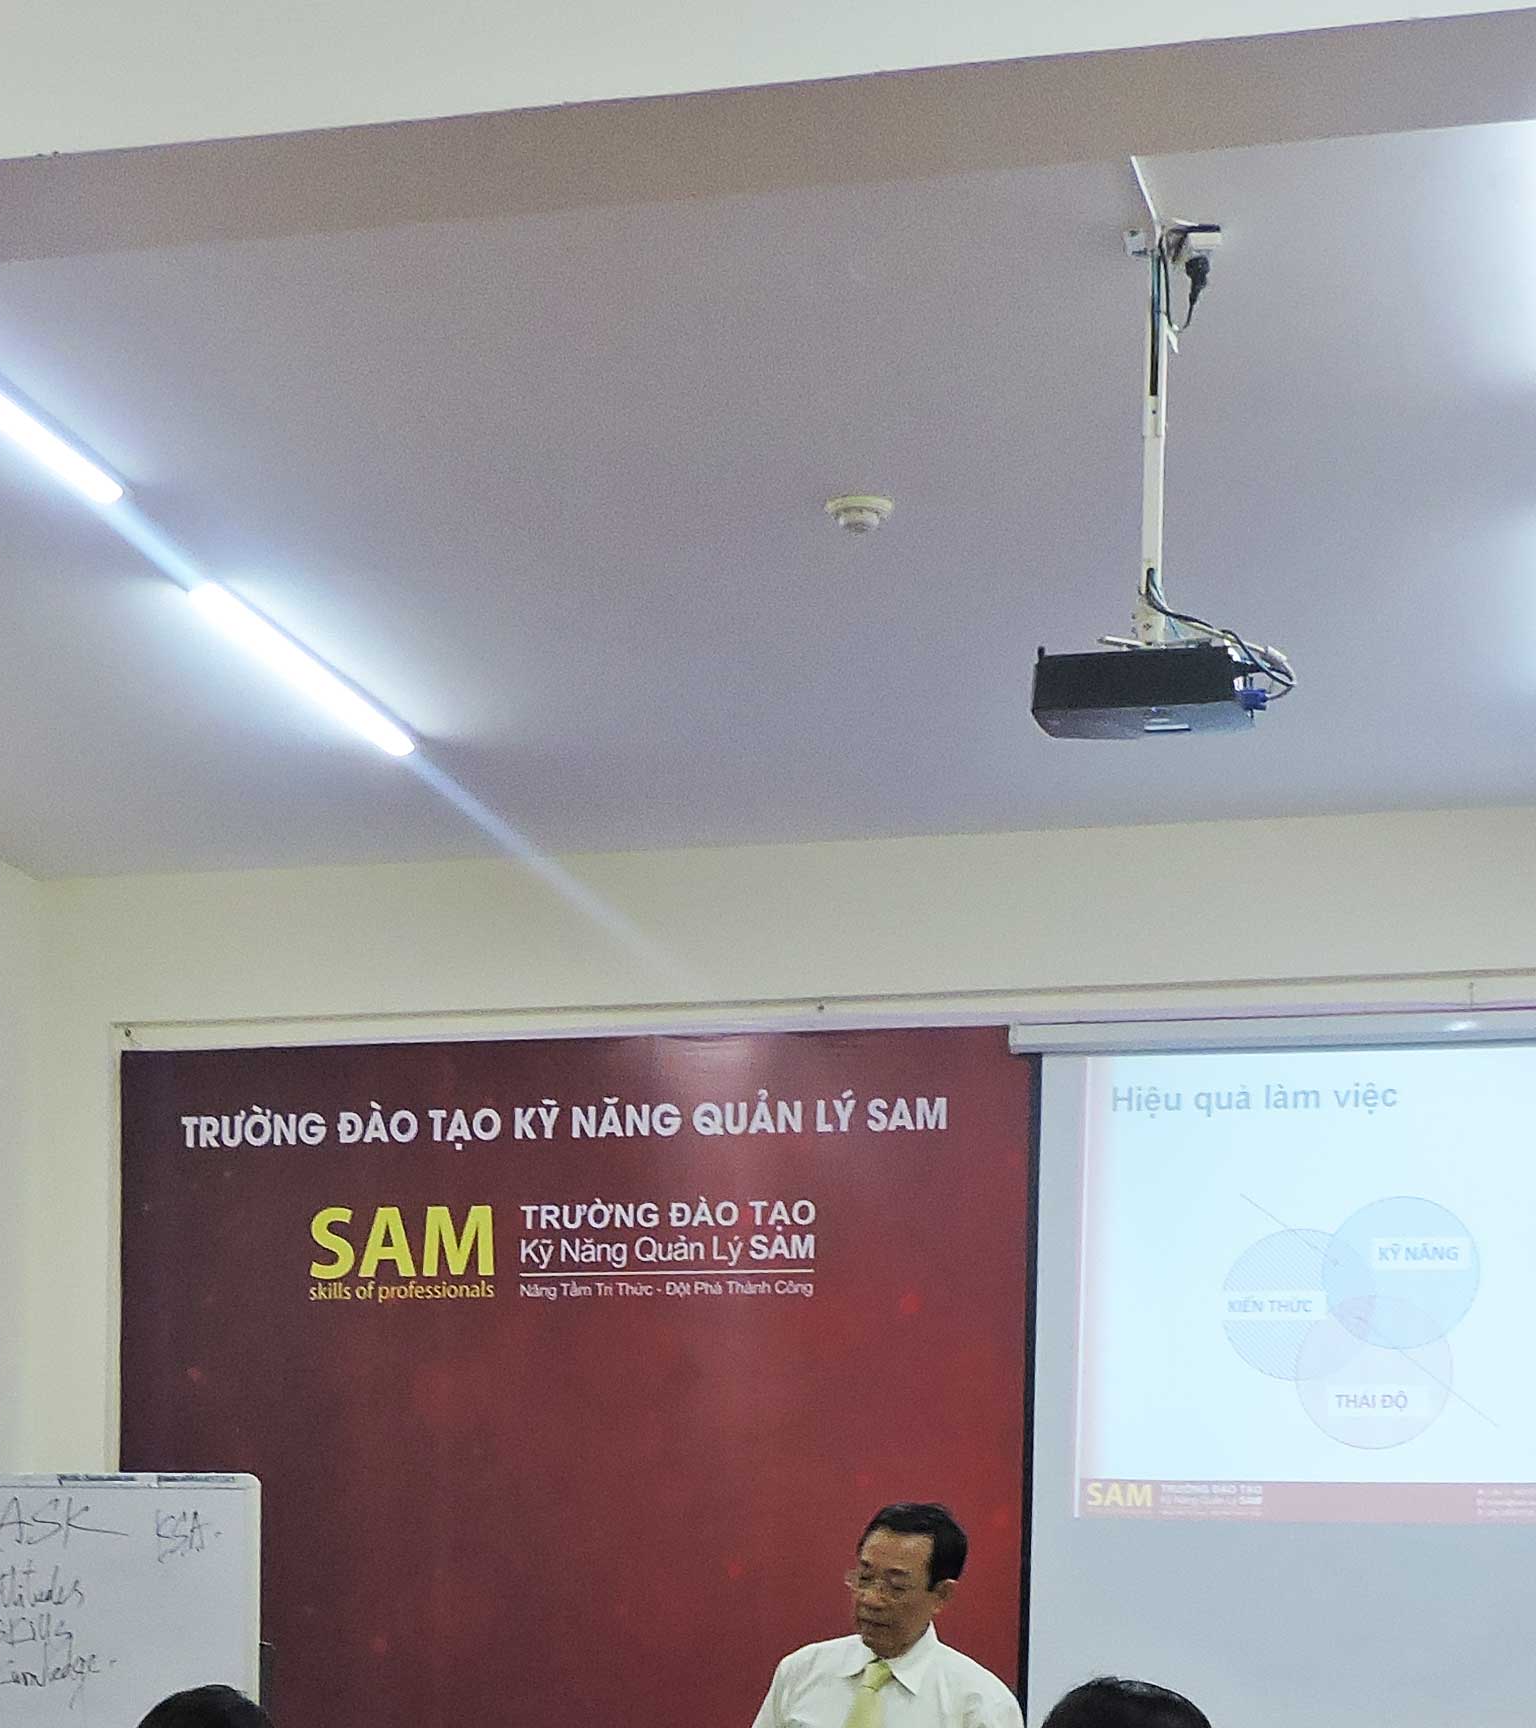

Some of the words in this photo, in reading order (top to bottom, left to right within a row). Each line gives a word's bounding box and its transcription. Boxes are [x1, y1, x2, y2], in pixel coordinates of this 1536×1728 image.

[1111, 1085, 1182, 1119] Hiệu
[1193, 1084, 1252, 1118] quả
[1264, 1084, 1321, 1110] làm
[1333, 1081, 1399, 1116] việc
[180, 1104, 327, 1149] TRƯỜNG
[337, 1100, 419, 1144] ĐÀO
[428, 1107, 502, 1151] TẠO
[513, 1098, 561, 1140] KỸ
[570, 1096, 683, 1139] NĂNG
[692, 1088, 803, 1136] QUẢN
[815, 1088, 857, 1133] LÝ
[866, 1096, 948, 1132] SAM
[519, 1198, 660, 1230] TRƯỜNG
[668, 1196, 739, 1228] ĐÀO
[748, 1199, 816, 1232] TẠO
[309, 1205, 496, 1280] SAM
[519, 1238, 555, 1270] Kỹ
[560, 1238, 628, 1269] Năng
[633, 1235, 705, 1263] Quản
[712, 1234, 743, 1267] Lý
[749, 1234, 816, 1260] SAM
[309, 1282, 352, 1301] skills
[355, 1281, 376, 1300] of
[378, 1280, 496, 1303] professionals
[1086, 1482, 1154, 1508] SAM
